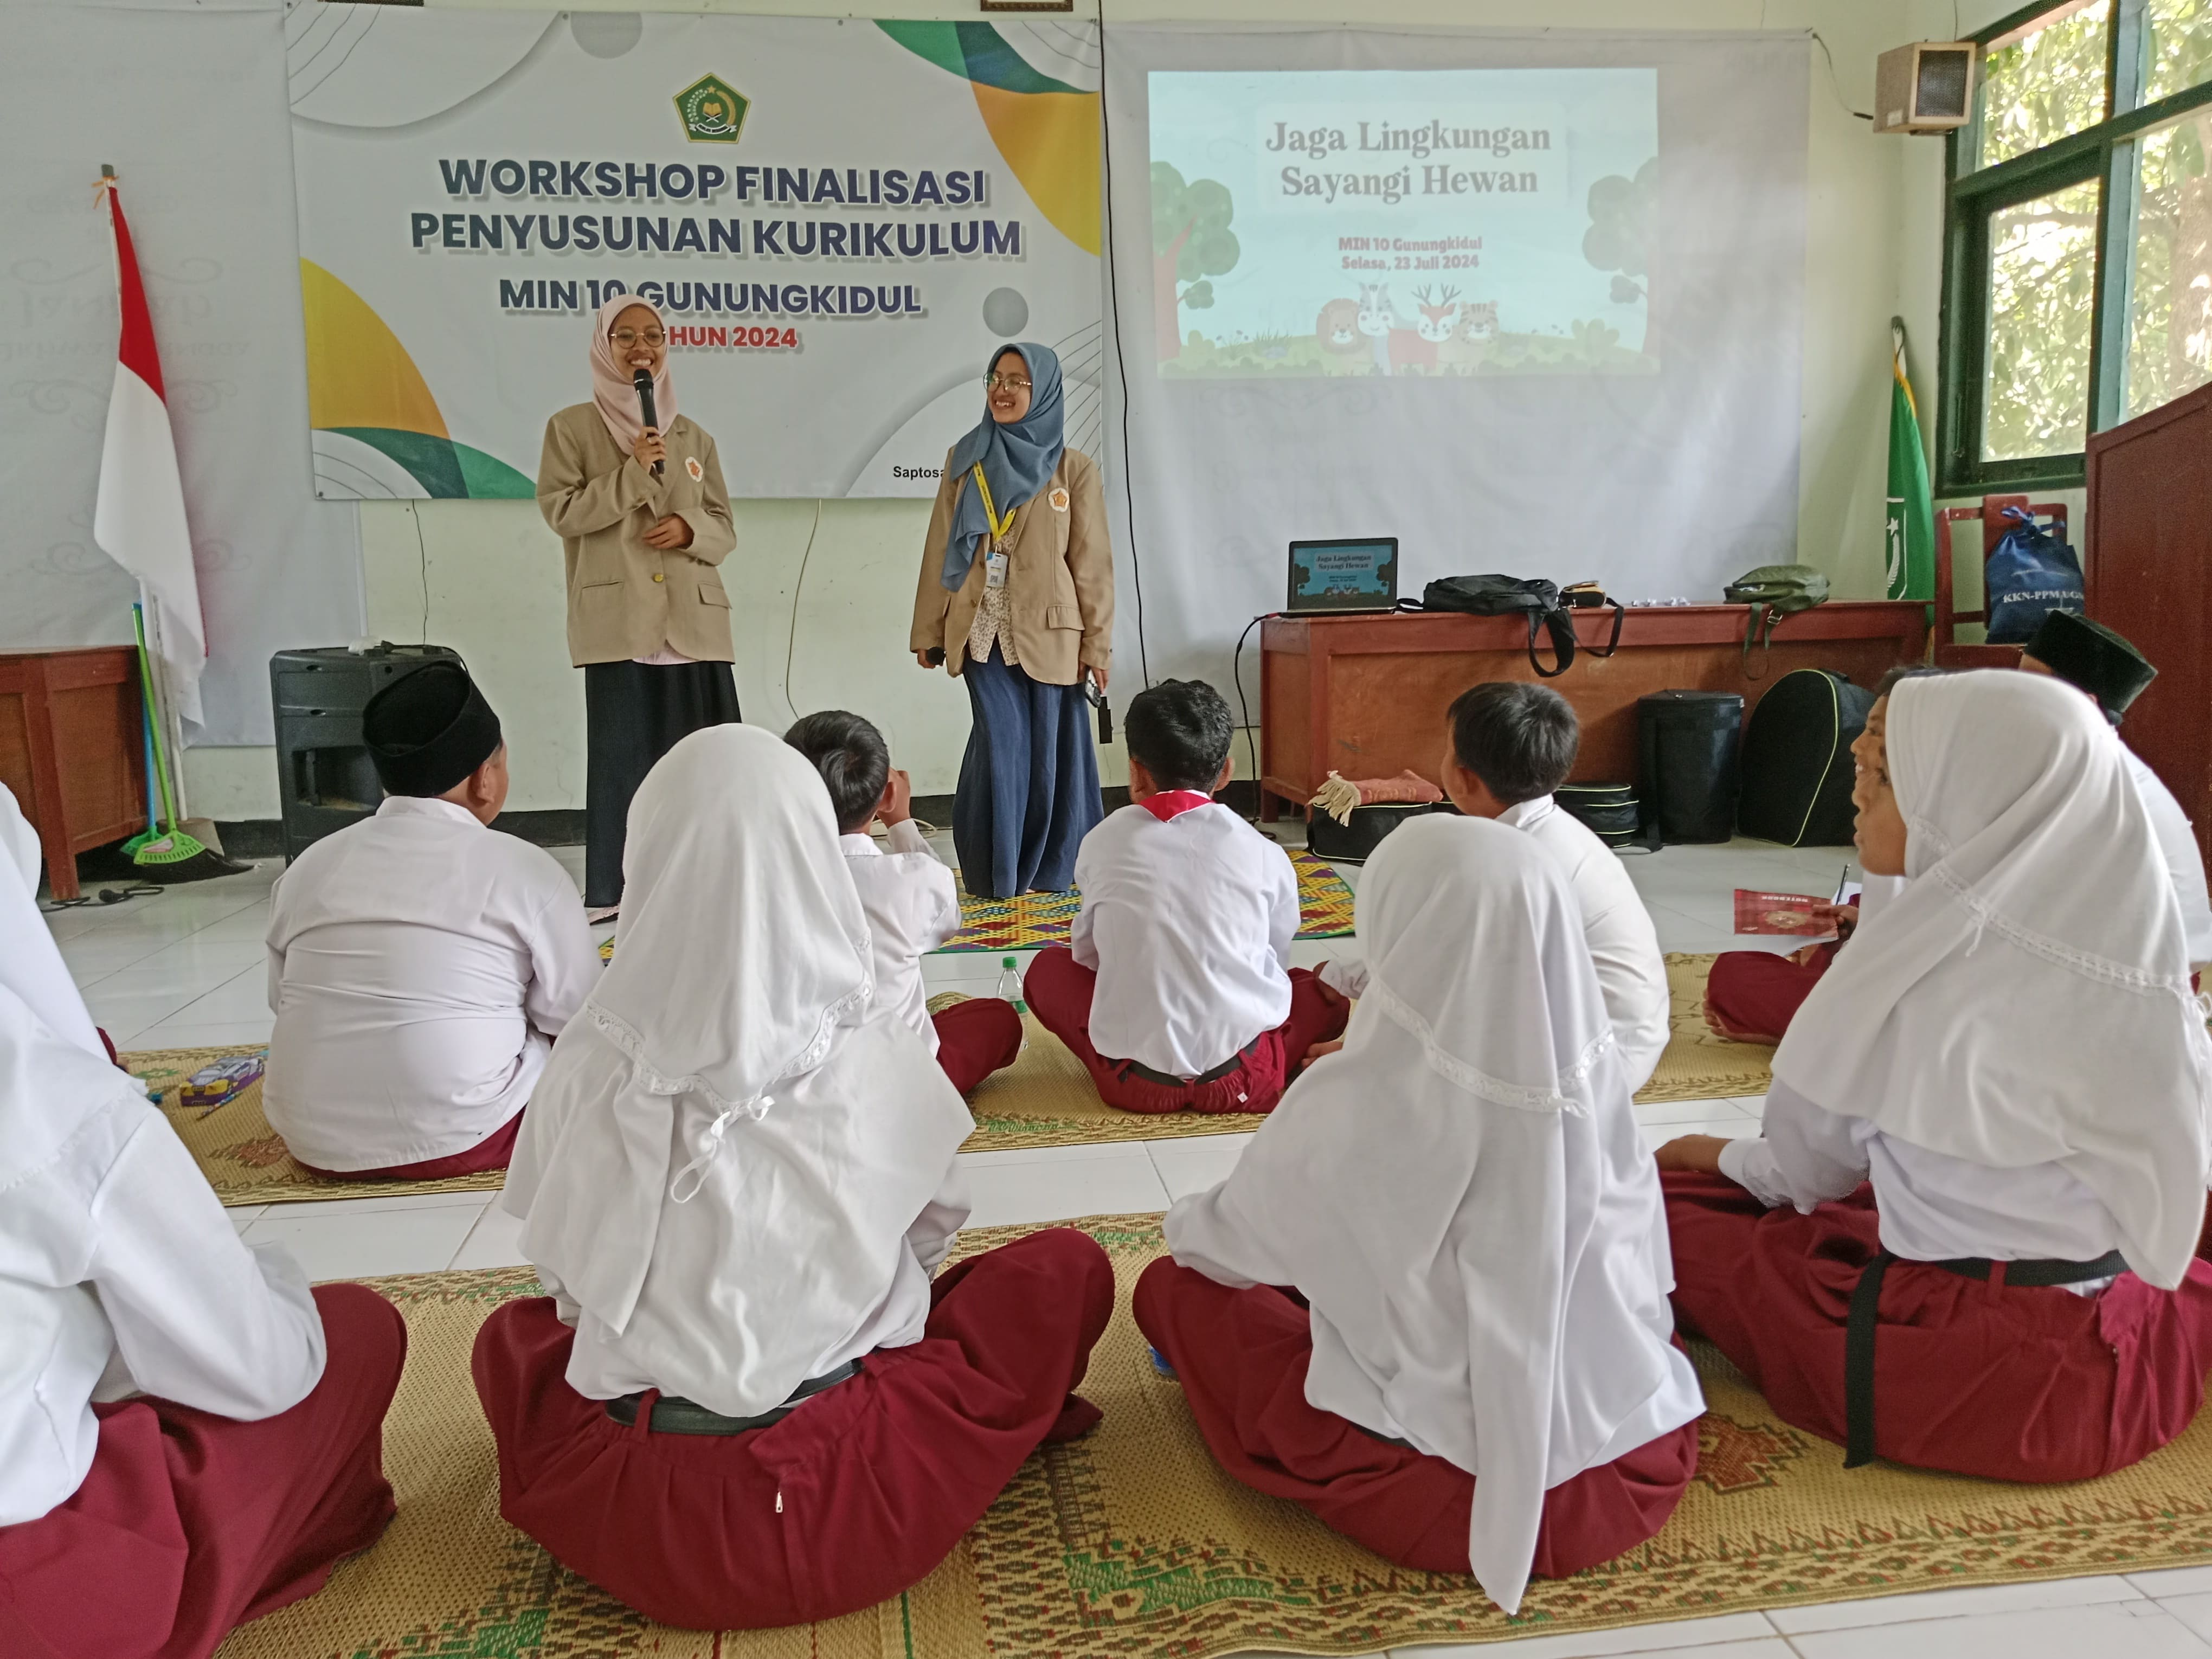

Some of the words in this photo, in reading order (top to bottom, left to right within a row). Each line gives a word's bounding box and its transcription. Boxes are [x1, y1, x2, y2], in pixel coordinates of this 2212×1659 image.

[1266, 121, 1347, 159] Jaga
[1358, 120, 1551, 158] Lingkungan
[439, 159, 725, 198] WORKSHOP
[736, 166, 984, 204] FINALISASI
[1282, 165, 1411, 204] Sayangi
[1422, 165, 1538, 195] Hewan
[411, 213, 741, 253] PENYUSUNAN
[753, 220, 1020, 256] KURIKULUM
[1339, 237, 1370, 250] MIN
[1373, 237, 1390, 250] 10
[1393, 236, 1482, 253] Gunungkidul
[1342, 256, 1391, 271] Selasa,
[1394, 256, 1411, 270] 23
[1414, 257, 1439, 270] Juli
[1443, 255, 1479, 269] 2024
[500, 279, 578, 309] MIN
[586, 279, 627, 309] 10
[636, 281, 922, 313] GUNUNGKIDUL
[669, 326, 727, 346] HUN
[733, 326, 798, 348] 2024
